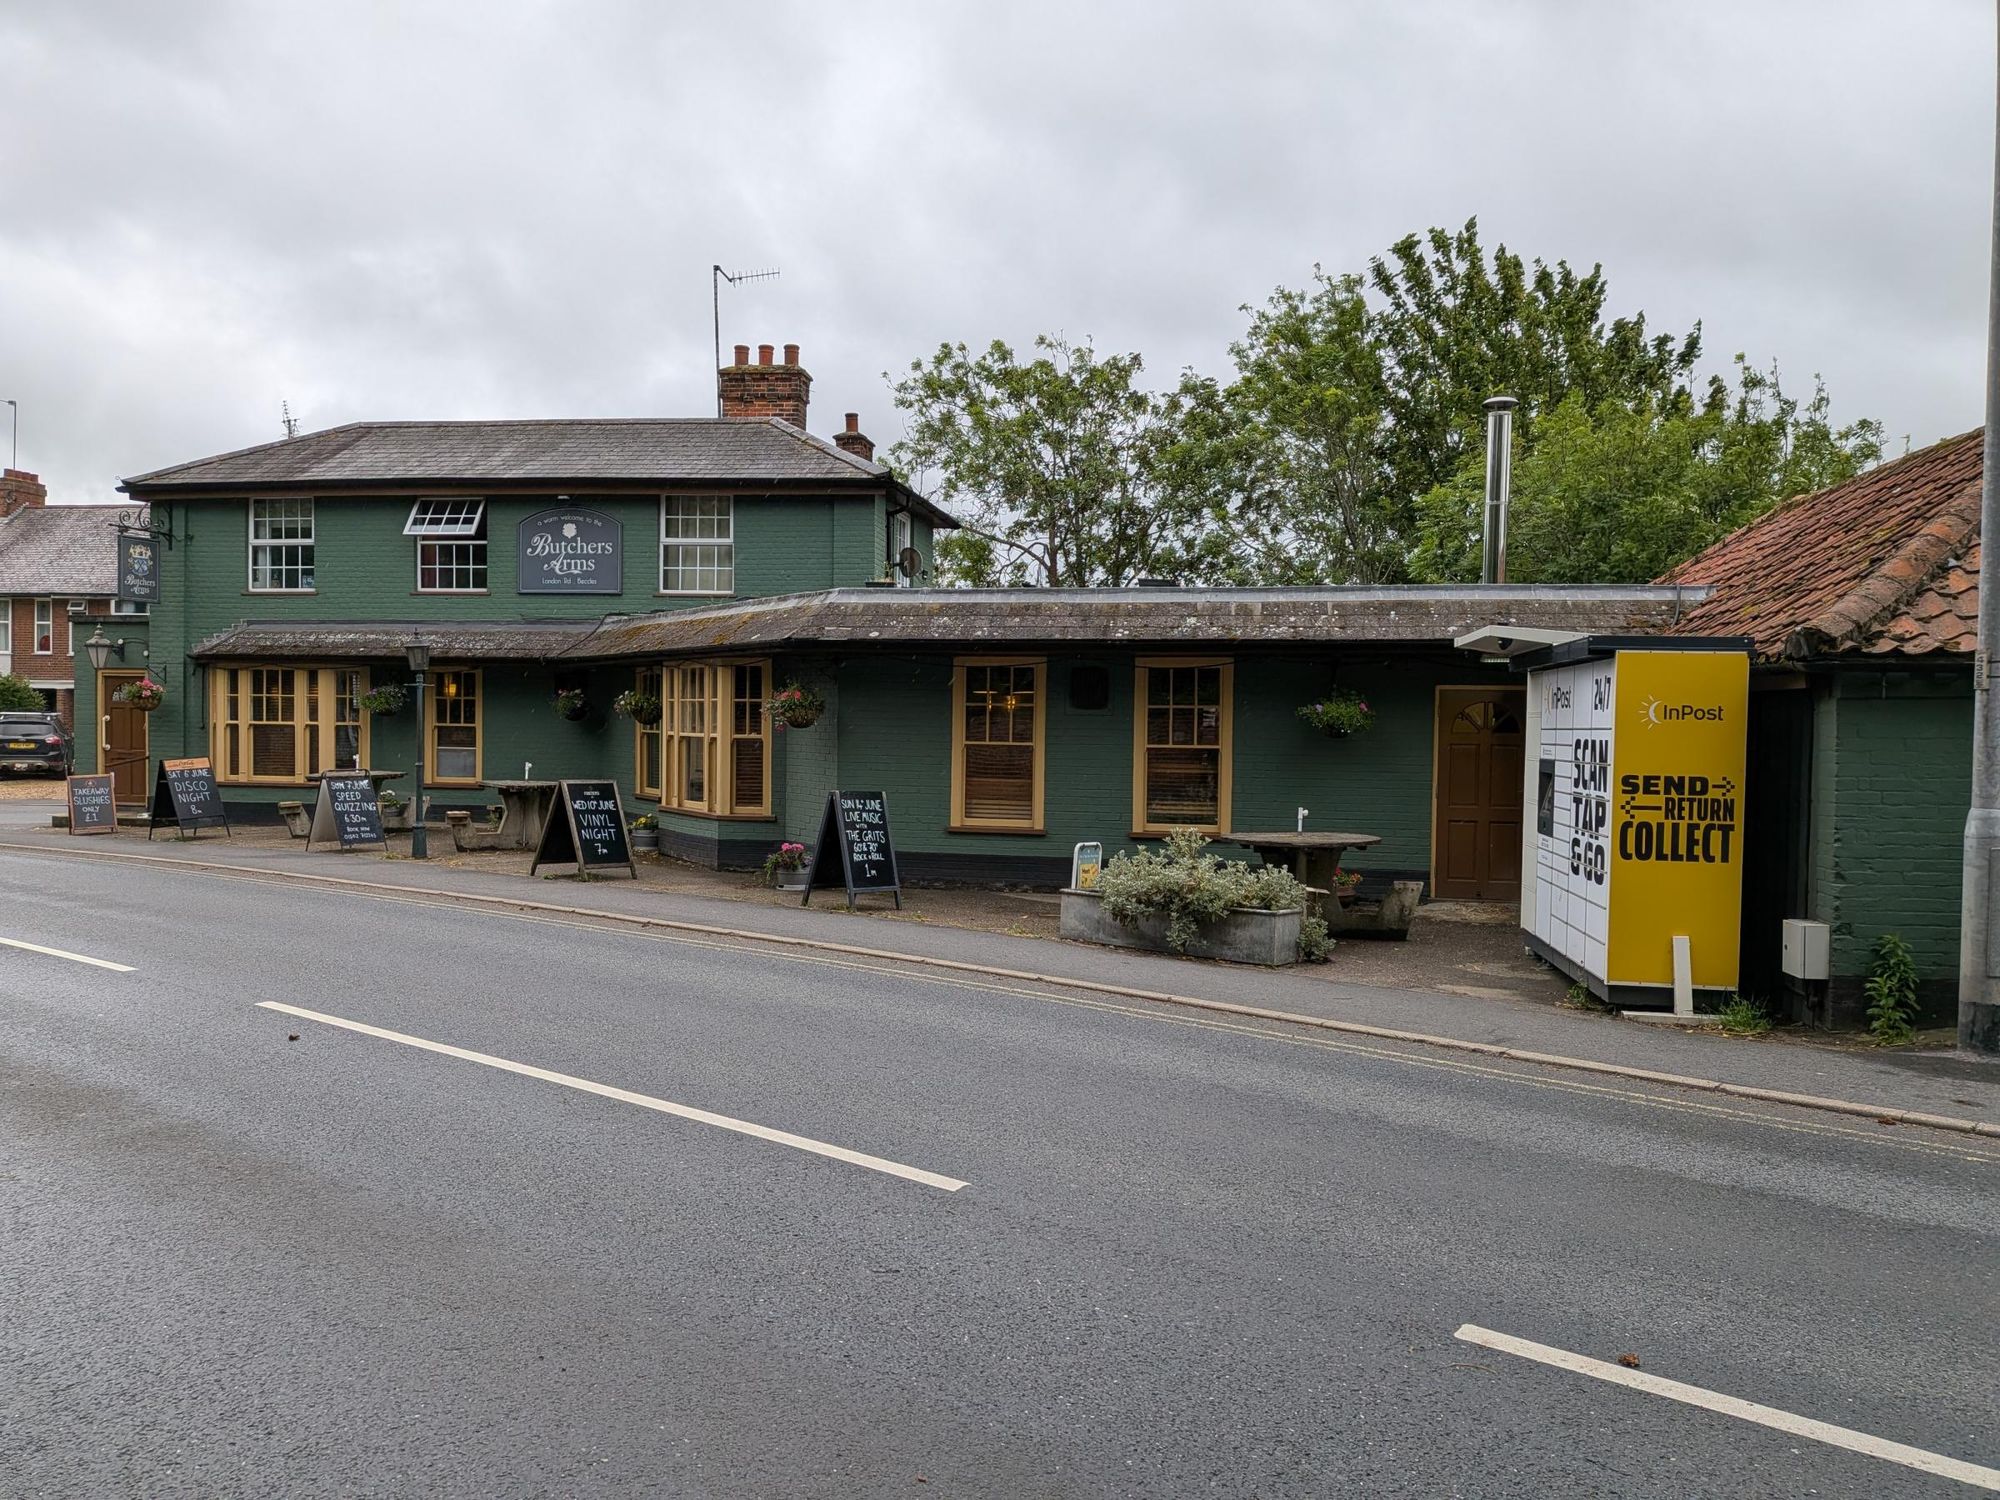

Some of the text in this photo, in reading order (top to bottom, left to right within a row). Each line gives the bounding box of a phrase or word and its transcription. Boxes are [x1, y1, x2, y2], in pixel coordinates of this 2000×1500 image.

[526, 533, 613, 556] Butchers
[543, 552, 595, 575] Arms
[124, 574, 156, 587] Butchers
[541, 577, 561, 585] London
[130, 585, 150, 595] Arms
[1551, 686, 1571, 710] InPost
[1594, 675, 1611, 712] 24/7
[1663, 705, 1724, 721] InPost
[1573, 738, 1608, 793] SCAN
[168, 770, 181, 778] SAT
[191, 769, 212, 778] JUNE
[73, 787, 110, 796] TAKEAWAY
[175, 781, 208, 792] DISCO
[1621, 775, 1709, 796] SEND
[73, 796, 111, 805] SLUSHIES
[178, 792, 211, 803] NIGHT
[336, 792, 361, 801] SPEED
[334, 802, 377, 811] QUIZZING
[572, 800, 587, 810] WED
[598, 800, 616, 811] JUNE
[840, 799, 855, 809] SUN
[864, 800, 883, 811] JUNE
[1664, 798, 1735, 822] RETURN
[85, 813, 99, 822] £1
[579, 814, 615, 827] VINYL
[844, 812, 883, 824] LIVE MUSIC
[1572, 791, 1606, 841] TAP
[581, 828, 616, 840] NIGHT
[845, 830, 886, 844] THE GRITS
[1619, 821, 1735, 863] COLLECT
[853, 852, 867, 862] ROCK
[871, 852, 885, 861] ROLL
[1571, 837, 1606, 886] & GO
